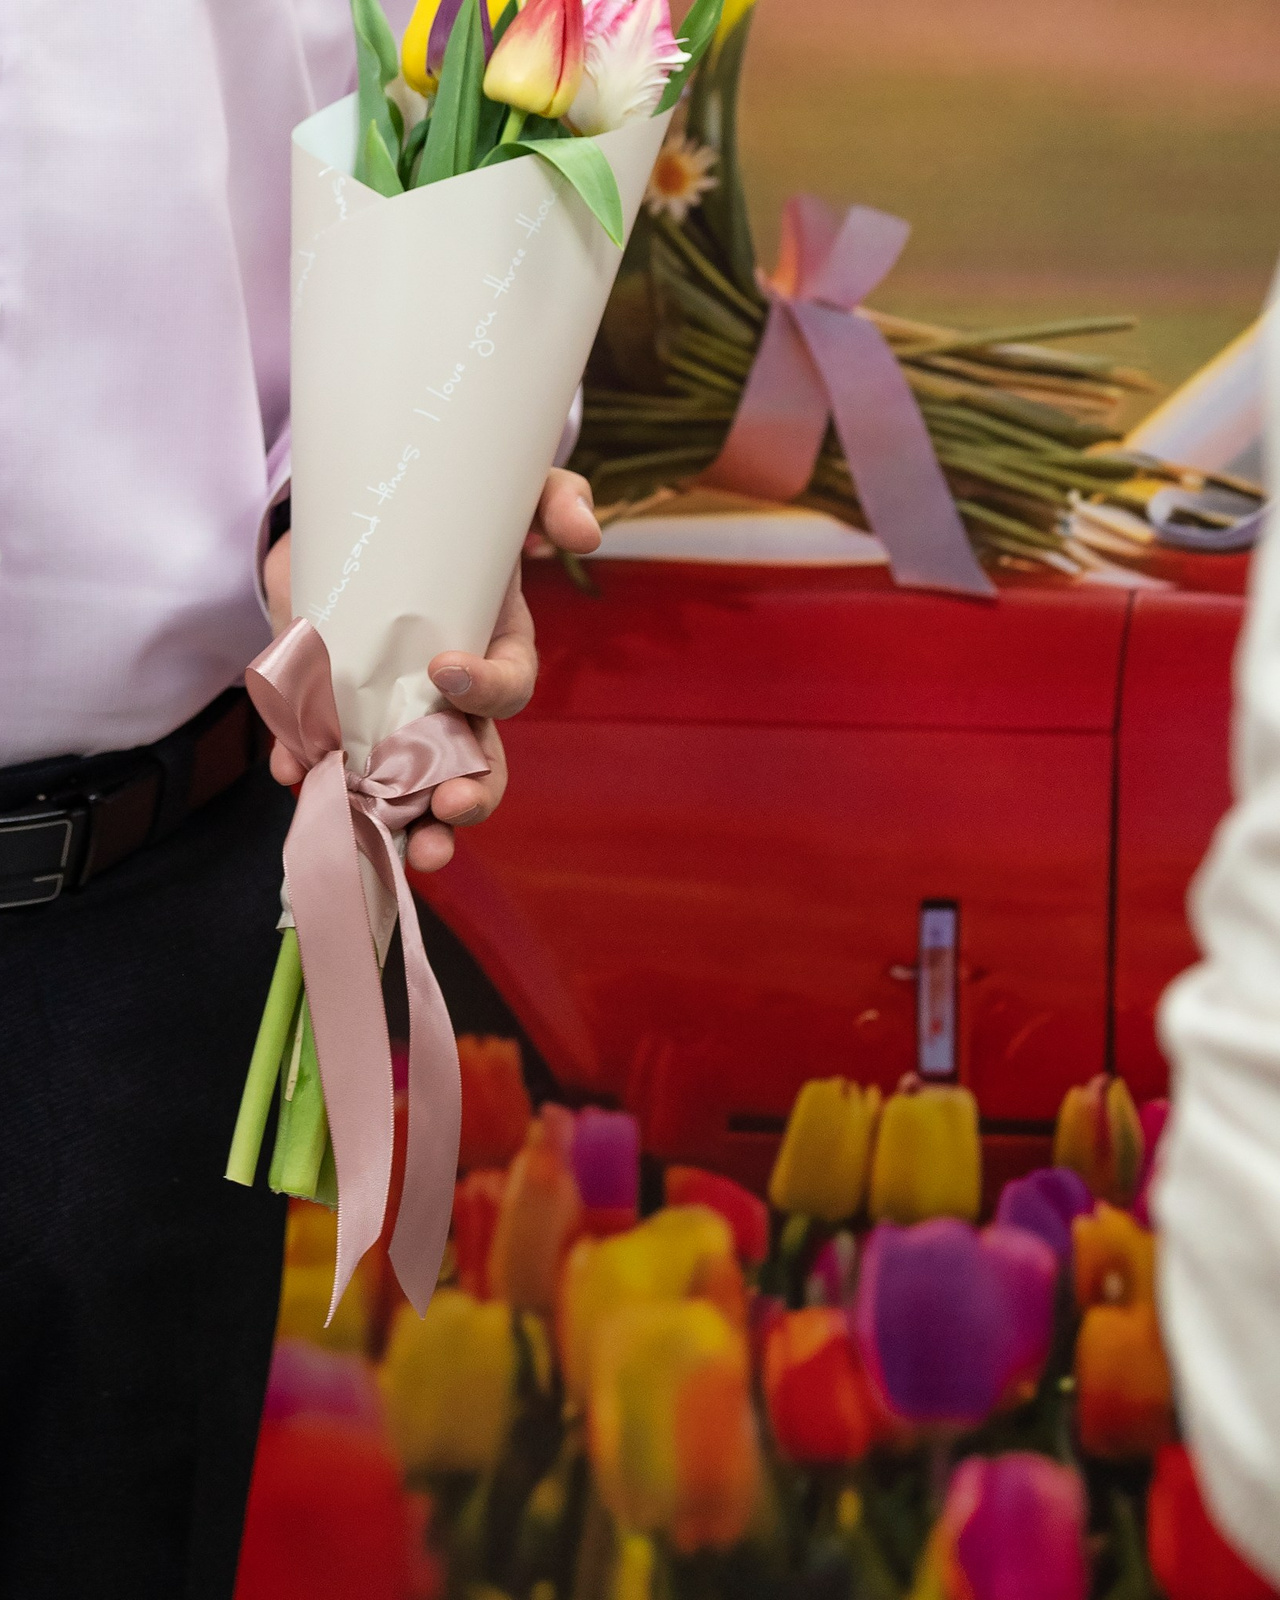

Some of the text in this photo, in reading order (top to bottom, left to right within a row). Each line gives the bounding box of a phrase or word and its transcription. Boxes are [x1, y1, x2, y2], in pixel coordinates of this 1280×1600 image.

[366, 444, 420, 505] times
[426, 362, 465, 402] love
[469, 310, 497, 357] you
[483, 247, 526, 299] three
